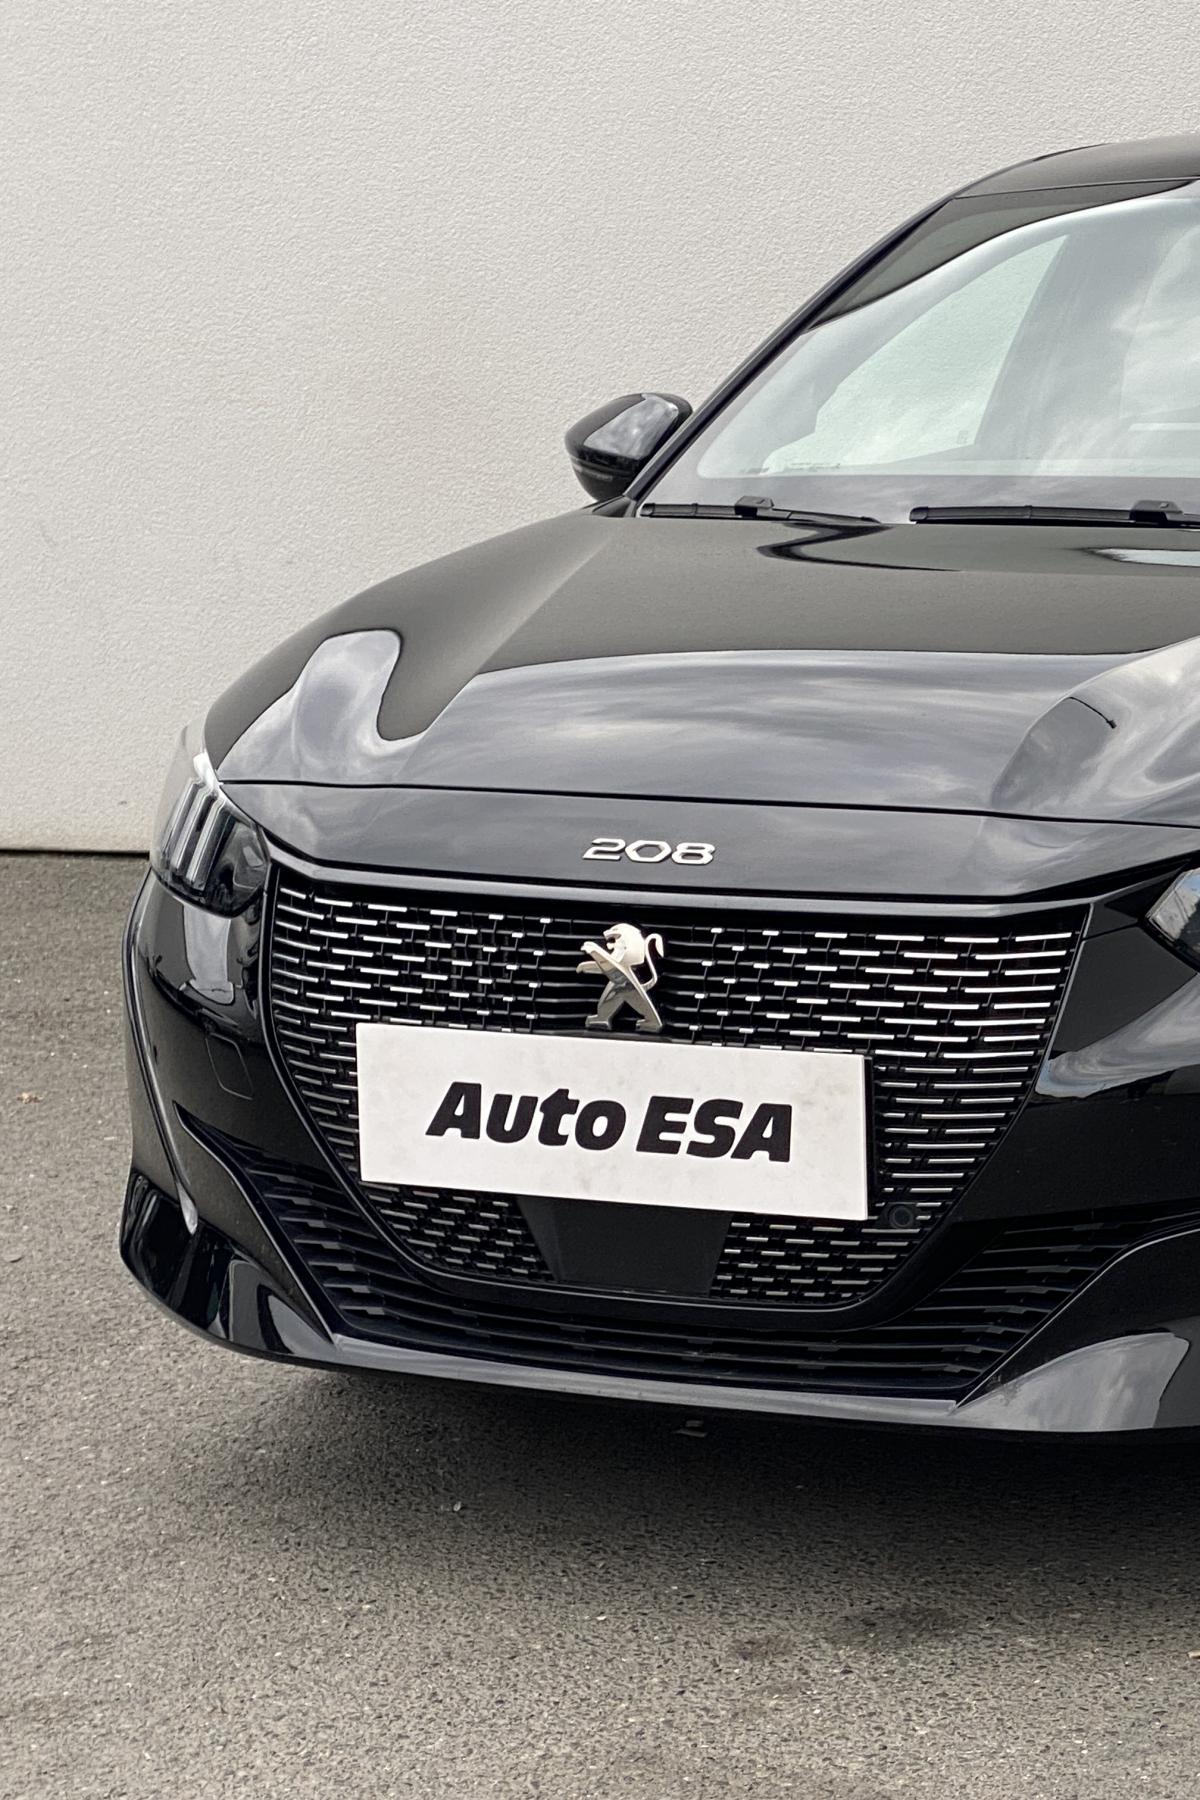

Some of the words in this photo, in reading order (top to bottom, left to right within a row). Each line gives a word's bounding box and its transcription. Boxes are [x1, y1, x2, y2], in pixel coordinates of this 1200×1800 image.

[582, 837, 716, 865] 208
[425, 1081, 627, 1151] Auto
[635, 1095, 793, 1163] ESA
